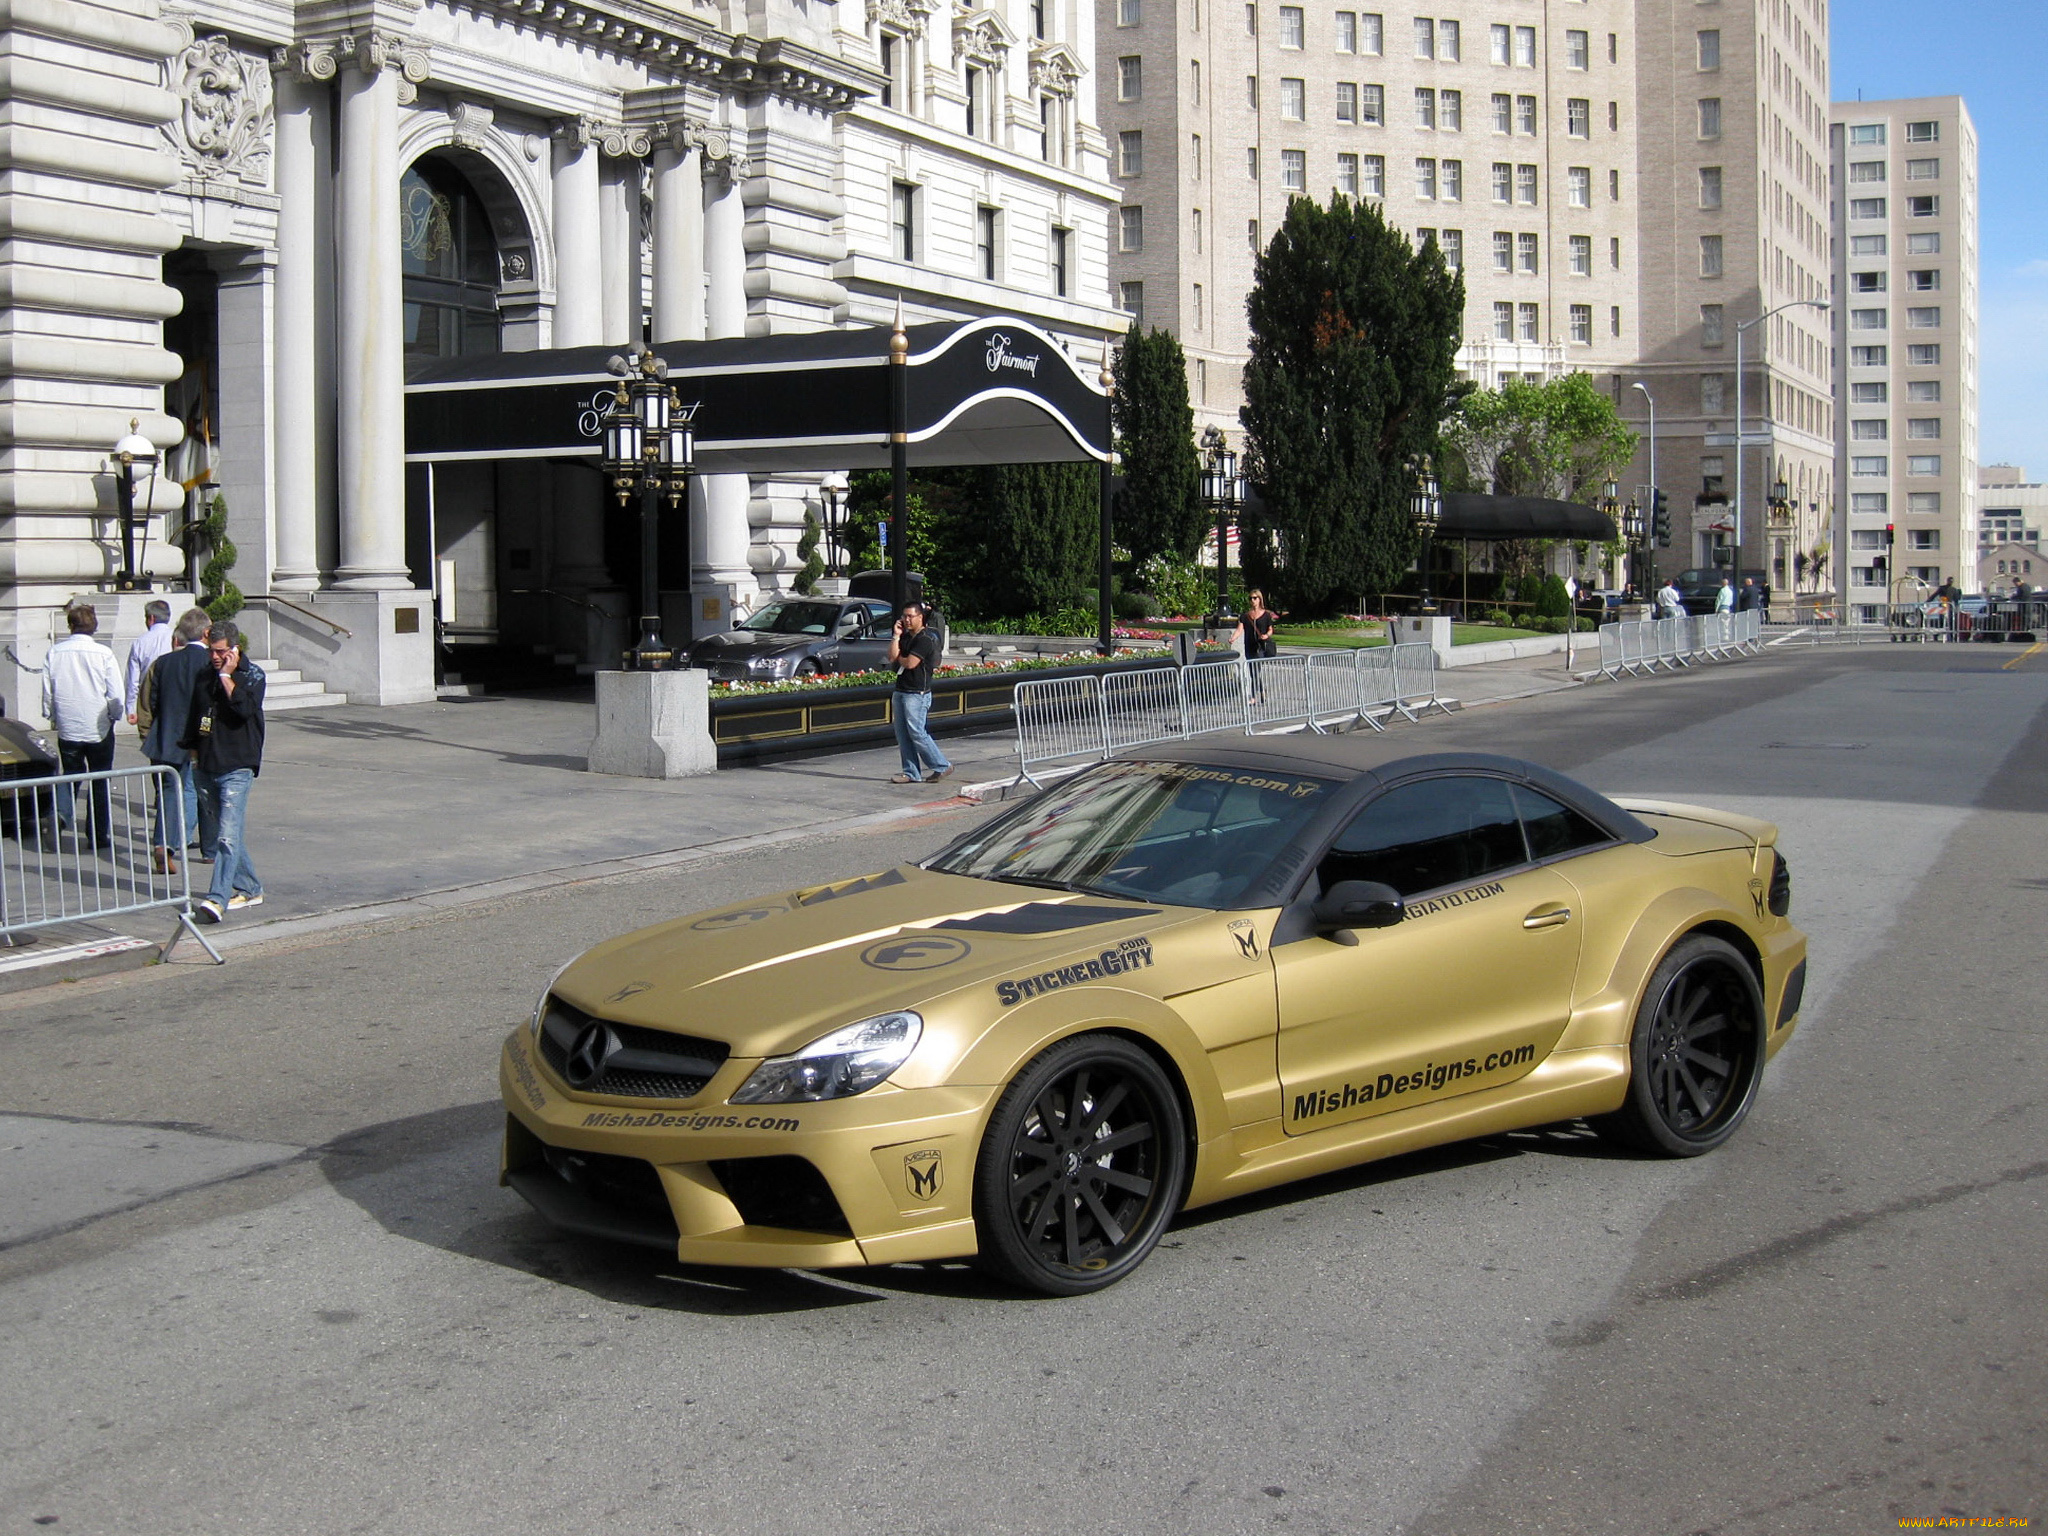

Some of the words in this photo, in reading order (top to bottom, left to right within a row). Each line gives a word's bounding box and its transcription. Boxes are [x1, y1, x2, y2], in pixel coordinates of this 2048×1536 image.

[986, 333, 1040, 378] Fairmont
[1293, 1044, 1535, 1121] MishaDesigns.com
[580, 1112, 799, 1131] MishaDesigns.com
[908, 1160, 938, 1197] M
